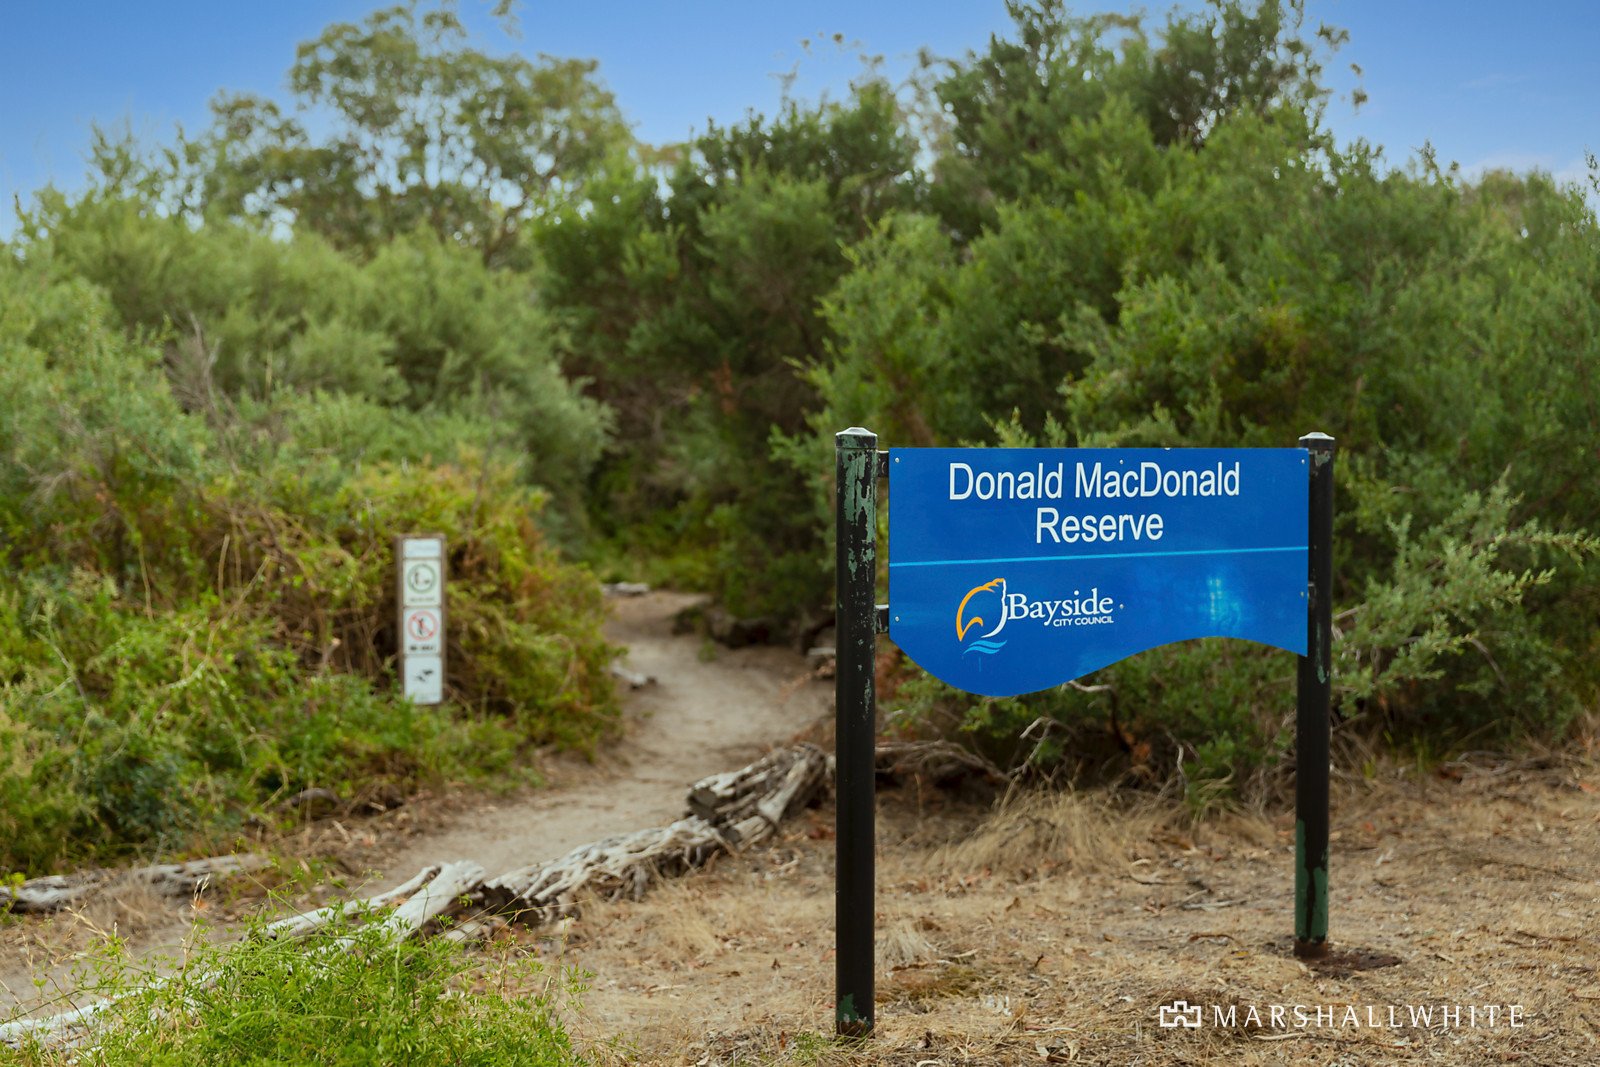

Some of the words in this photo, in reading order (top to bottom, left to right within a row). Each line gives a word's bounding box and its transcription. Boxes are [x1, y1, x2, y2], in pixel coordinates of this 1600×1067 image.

[949, 462, 1063, 501] Donald
[1075, 461, 1240, 498] MacDonald
[1036, 507, 1164, 544] Reserve
[1007, 587, 1114, 626] Bayside
[1052, 618, 1073, 627] CITY
[1074, 615, 1114, 626] COUNCIL
